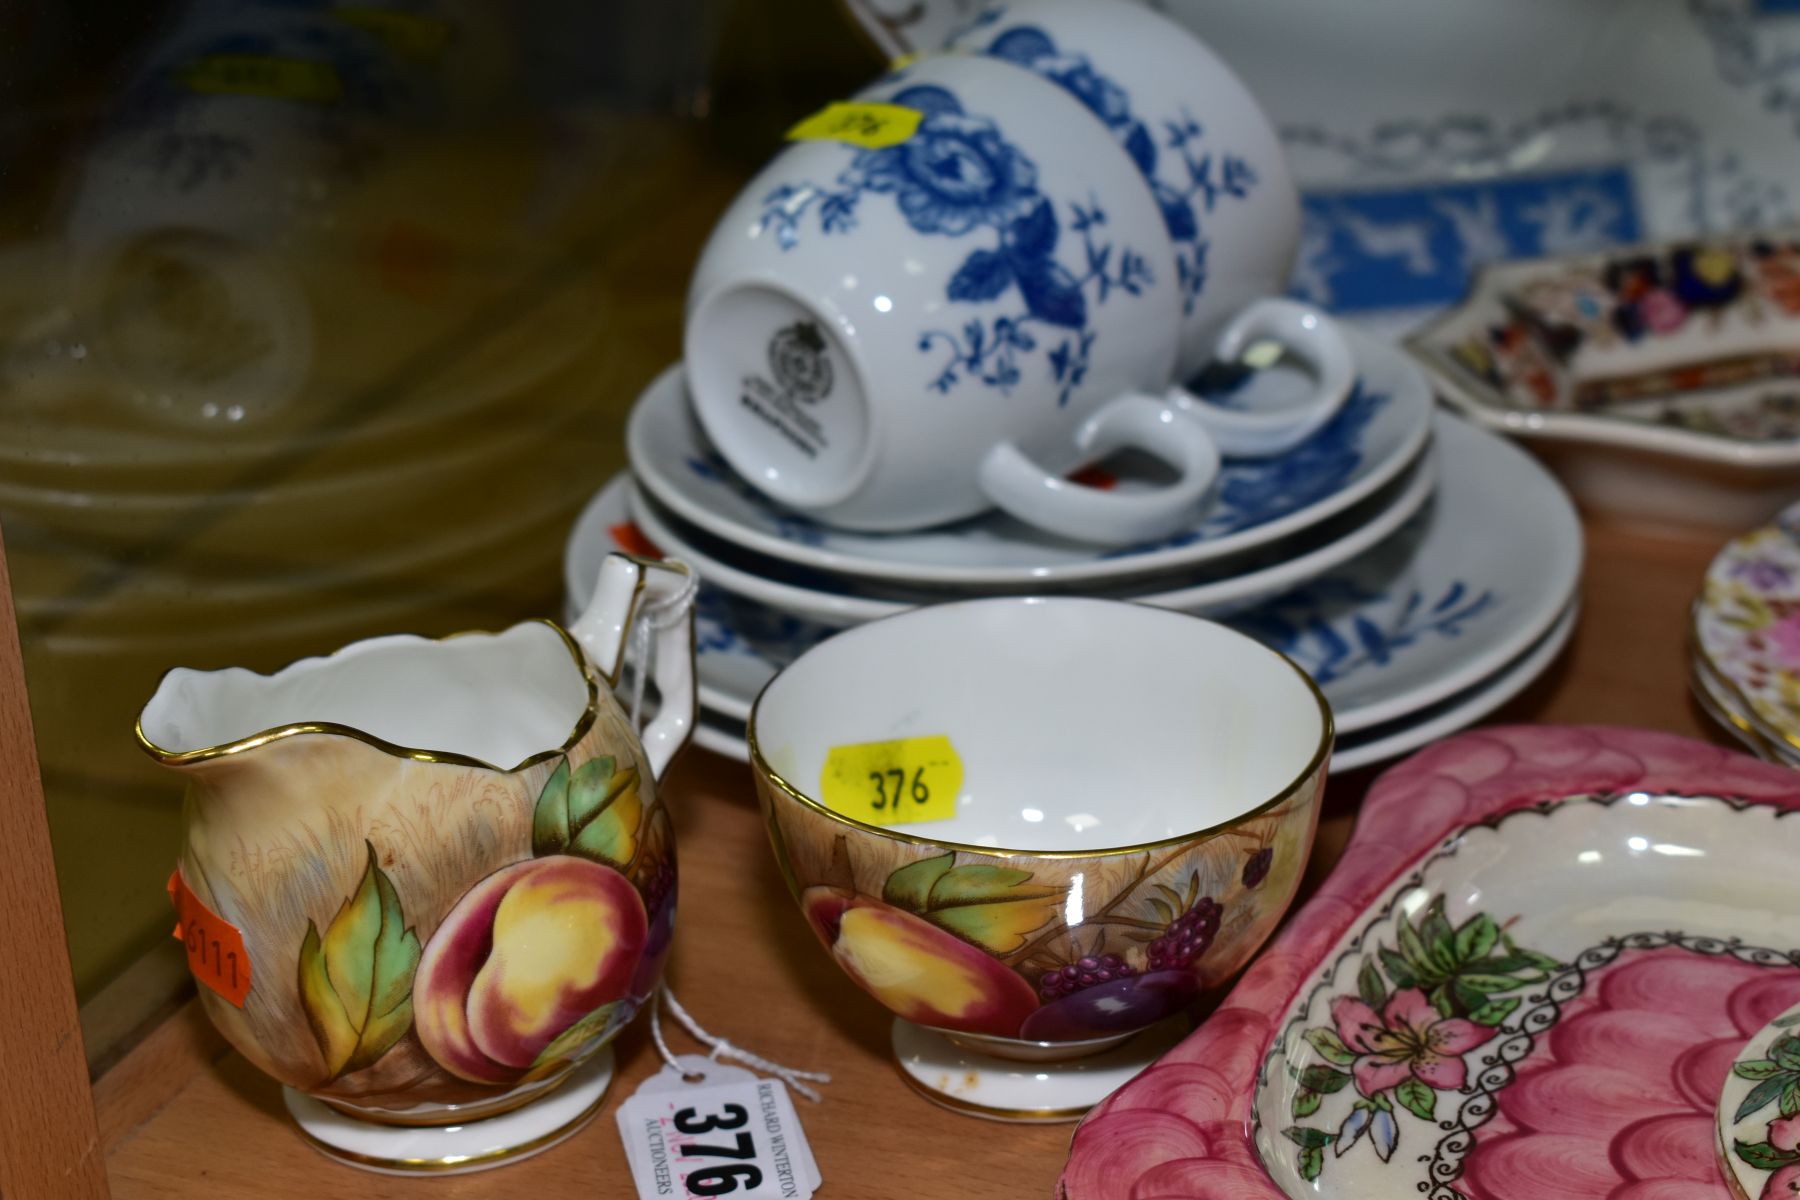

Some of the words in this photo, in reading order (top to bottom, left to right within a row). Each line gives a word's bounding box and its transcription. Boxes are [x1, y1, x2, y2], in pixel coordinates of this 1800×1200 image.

[868, 766, 929, 810] 376
[645, 1117, 673, 1195] AUCTIONEERS
[673, 1103, 763, 1197] 376
[757, 1083, 778, 1135] RICHARD
[770, 1134, 798, 1198] WINTERTON
